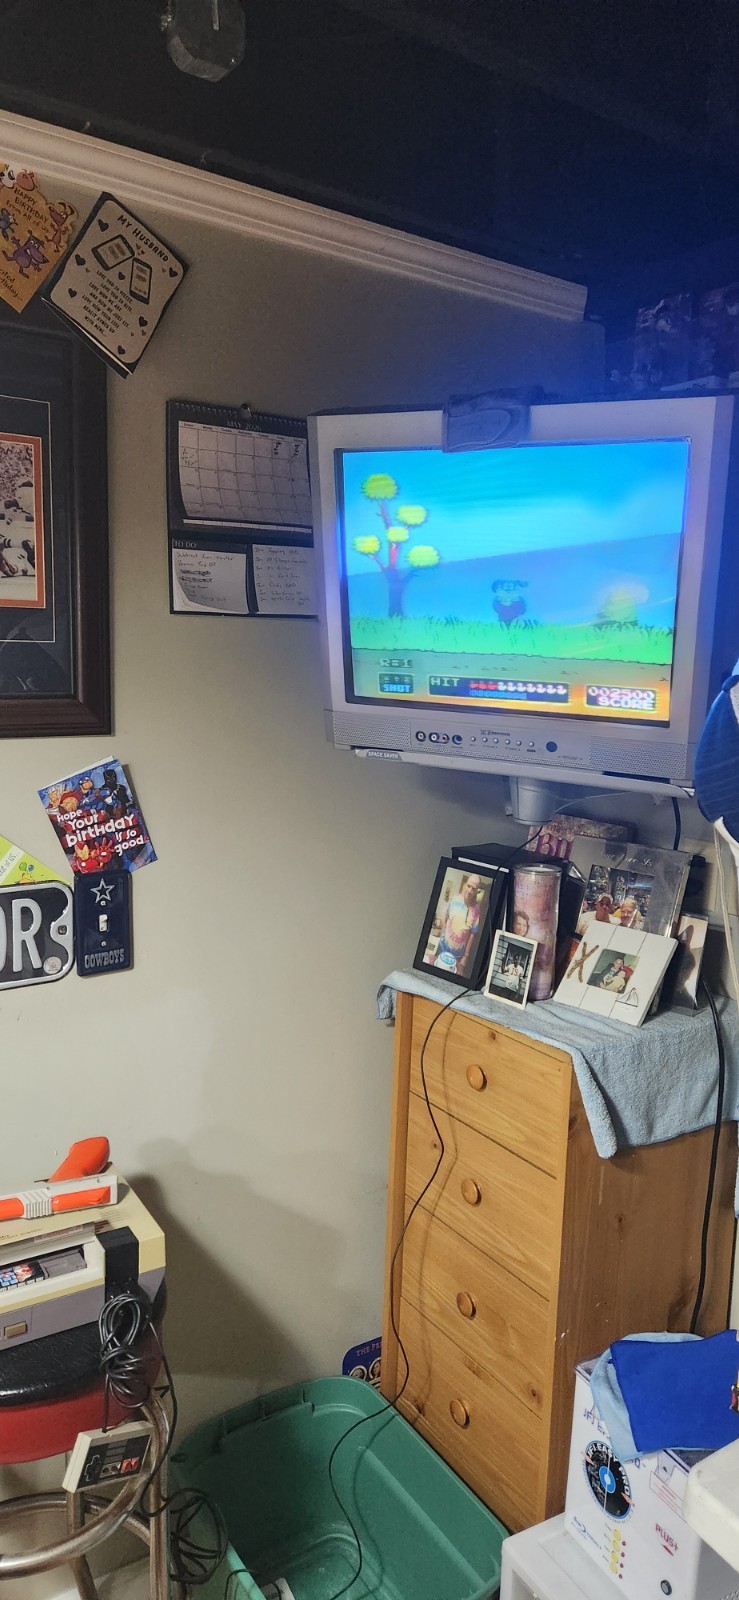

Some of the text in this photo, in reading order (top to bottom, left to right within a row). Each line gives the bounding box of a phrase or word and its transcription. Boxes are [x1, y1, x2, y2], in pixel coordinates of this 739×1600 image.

[13, 187, 36, 206] HAPPY
[13, 196, 48, 223] BIRTHDAY
[117, 214, 169, 262] MY HUSBAND
[382, 683, 411, 693] SHOT
[430, 676, 461, 688] HIT
[587, 685, 656, 700] 002500
[597, 696, 655, 711] SCORE
[57, 808, 83, 823] Hope
[114, 835, 146, 857] good
[84, 949, 125, 969] COWBOYS
